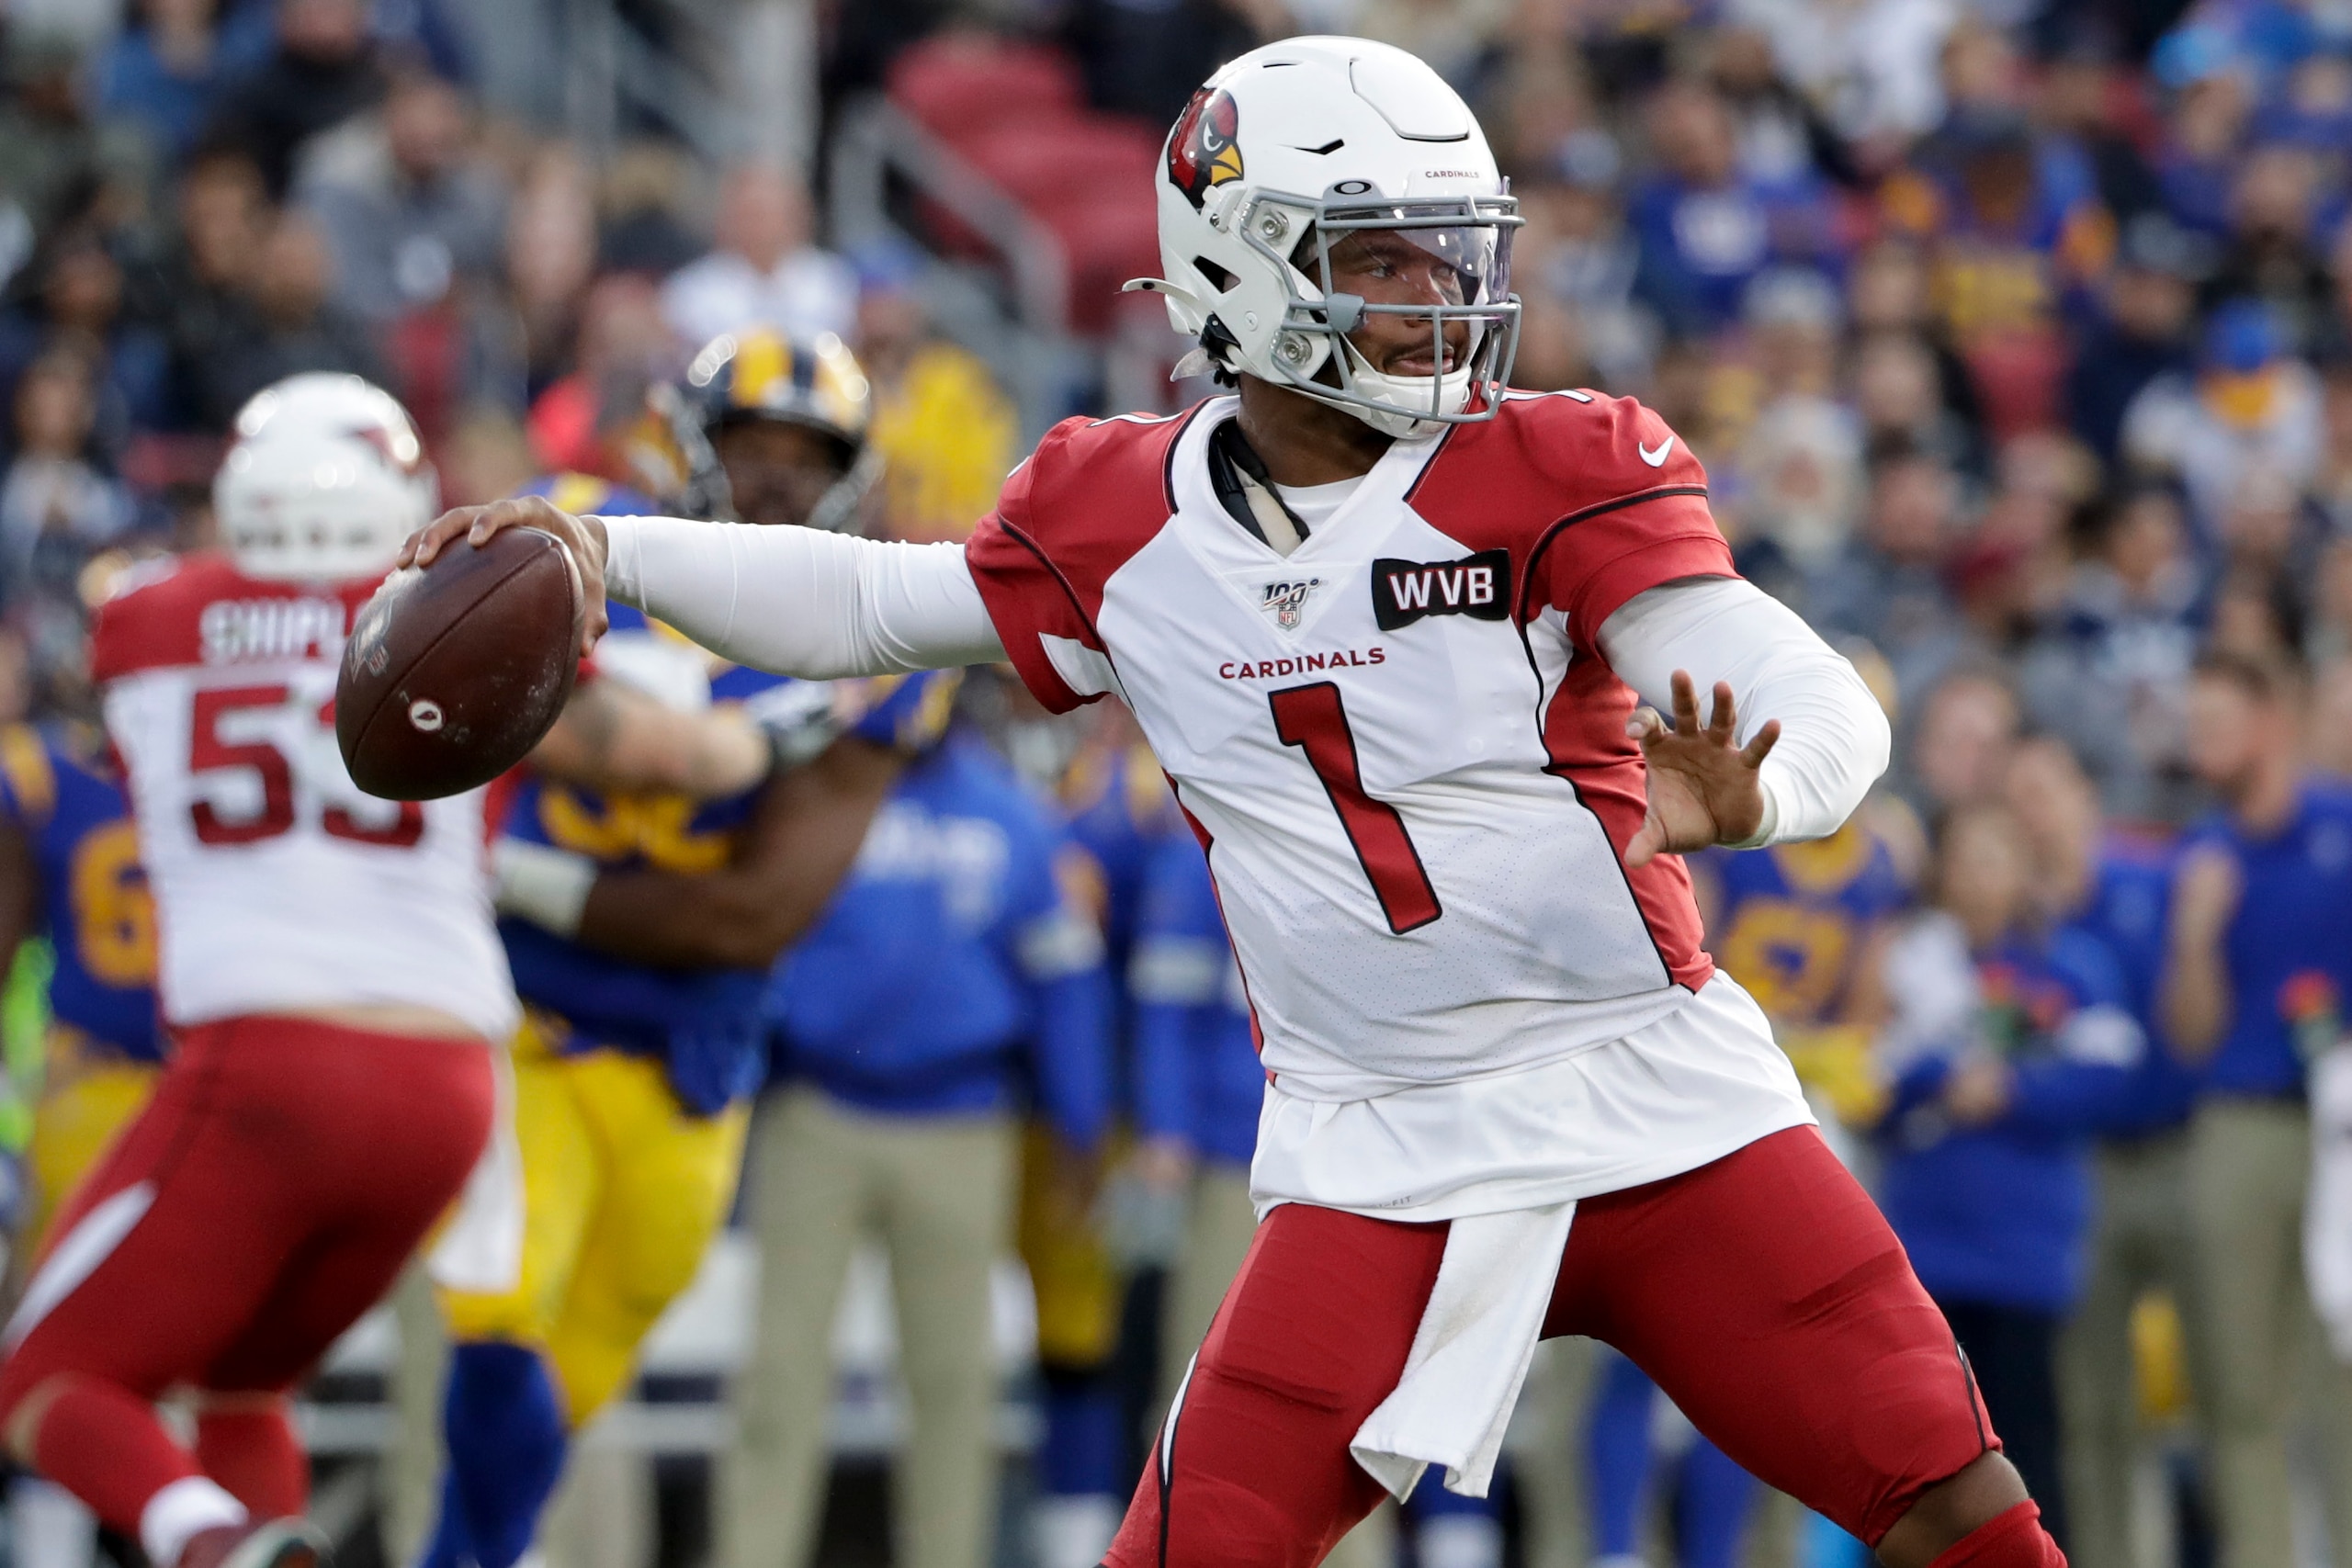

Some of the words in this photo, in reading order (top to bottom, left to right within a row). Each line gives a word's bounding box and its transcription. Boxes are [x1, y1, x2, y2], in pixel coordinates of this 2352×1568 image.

[1425, 170, 1479, 179] CARDINALS
[1389, 566, 1494, 612] WVB
[200, 598, 369, 661] SHIPL
[1279, 612, 1296, 624] NFL
[1219, 648, 1385, 680] CARDINALS
[1268, 681, 1443, 935] 1
